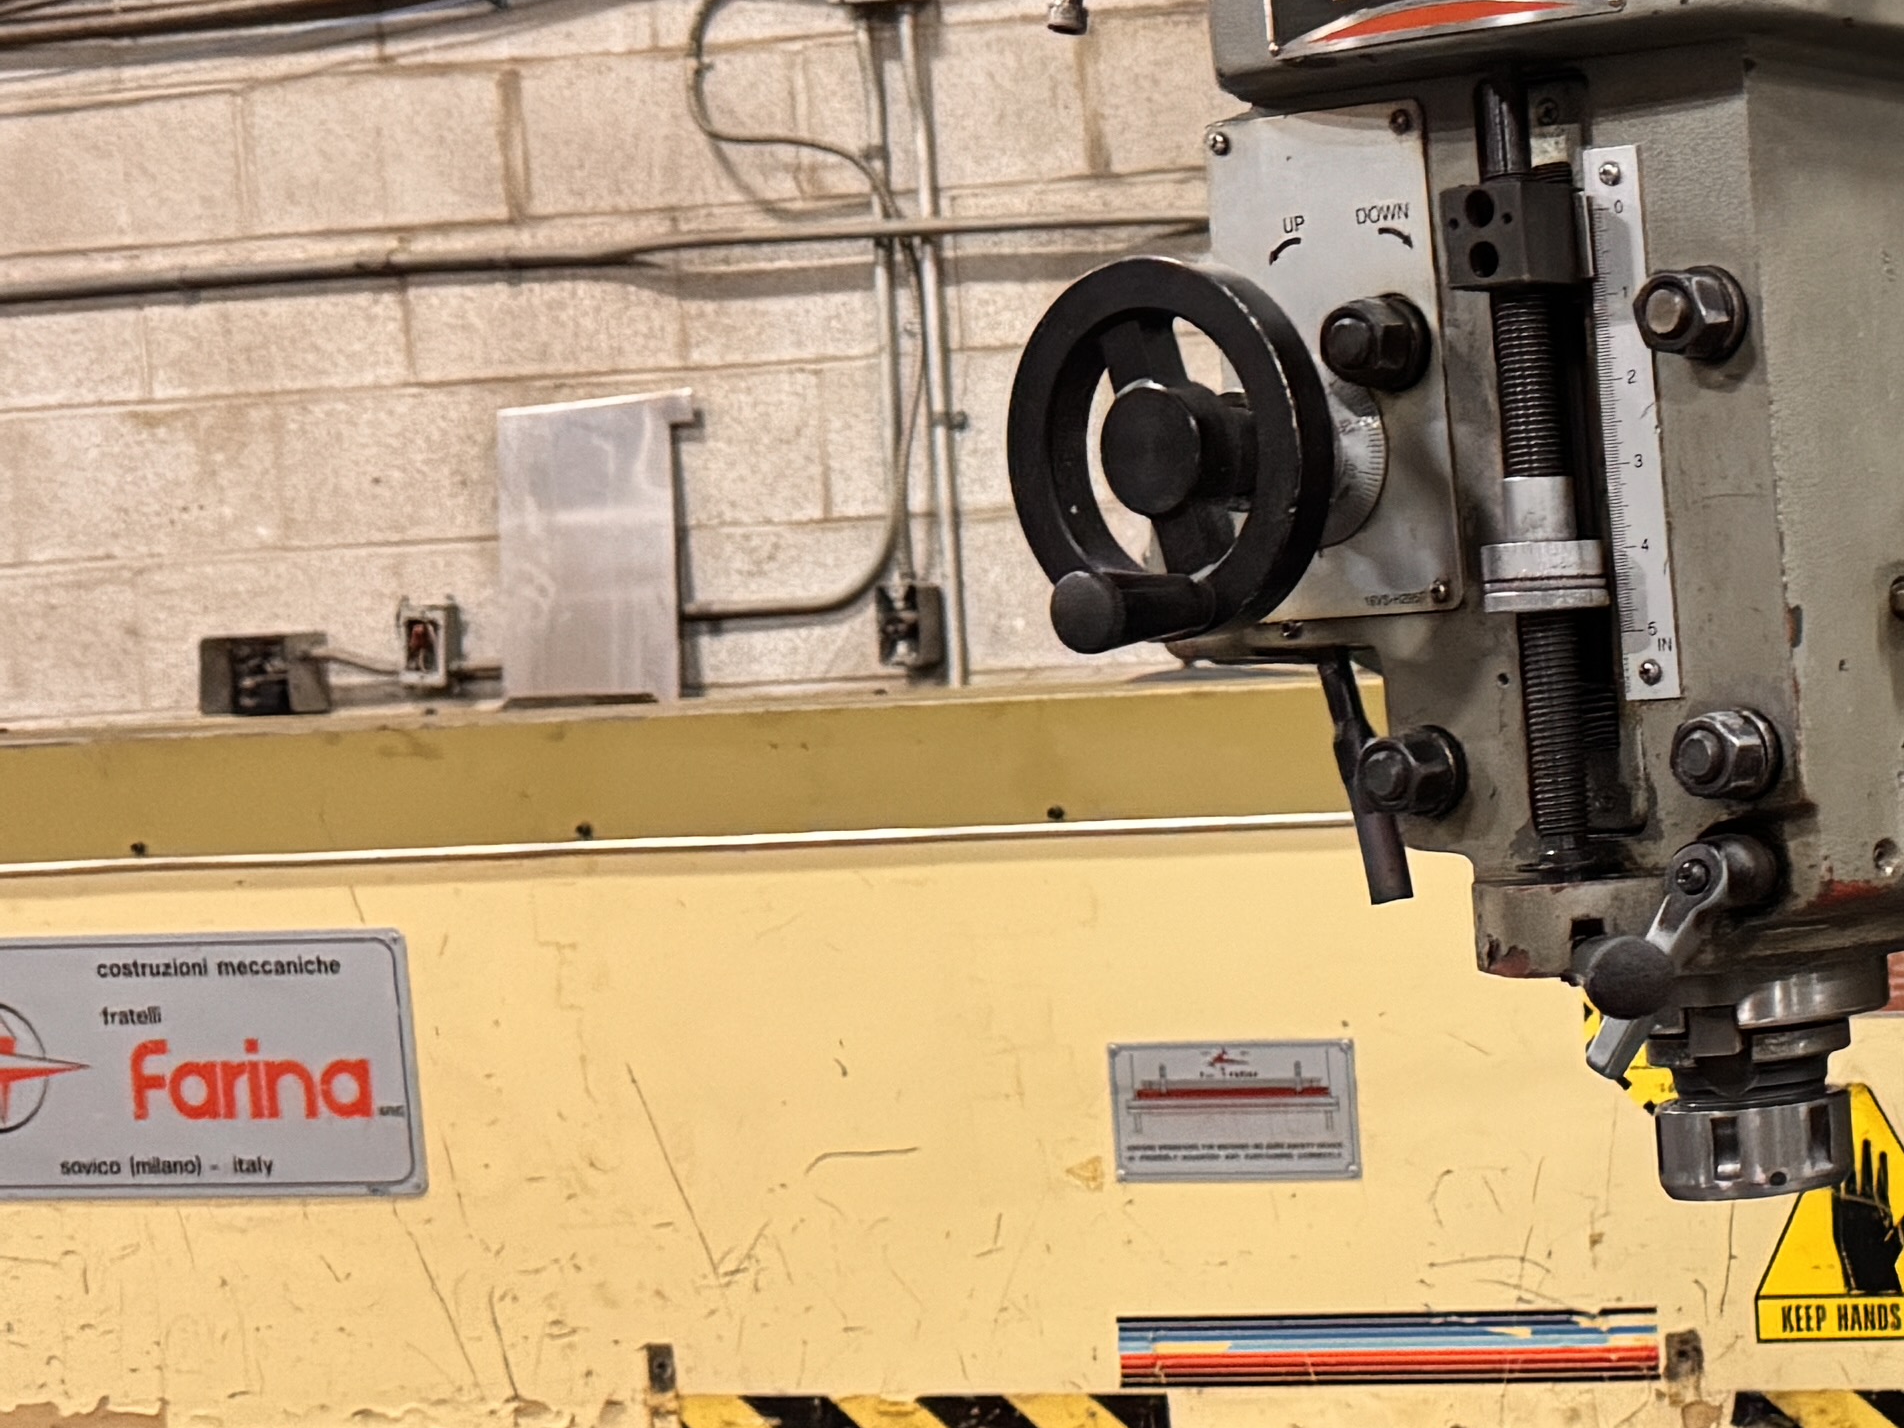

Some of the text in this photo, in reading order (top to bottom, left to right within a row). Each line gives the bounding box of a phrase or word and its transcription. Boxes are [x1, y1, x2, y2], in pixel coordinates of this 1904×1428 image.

[1355, 202, 1410, 224] DOWN
[1614, 199, 1623, 213] 0
[1283, 215, 1305, 233] UP
[1622, 286, 1627, 298] 1
[1627, 369, 1636, 384] 2
[1634, 454, 1643, 468] 3
[1641, 538, 1649, 551] 4
[1648, 622, 1657, 636] 5
[1658, 637, 1672, 652] IN
[97, 954, 341, 978] costruzioni meccaniche
[100, 1005, 162, 1025] fratelli
[60, 1156, 121, 1175] sovico
[130, 1154, 202, 1177] (milano)
[232, 1154, 274, 1177] italy
[1781, 1304, 1827, 1333] KEEP
[1837, 1303, 1902, 1332] HANDS
